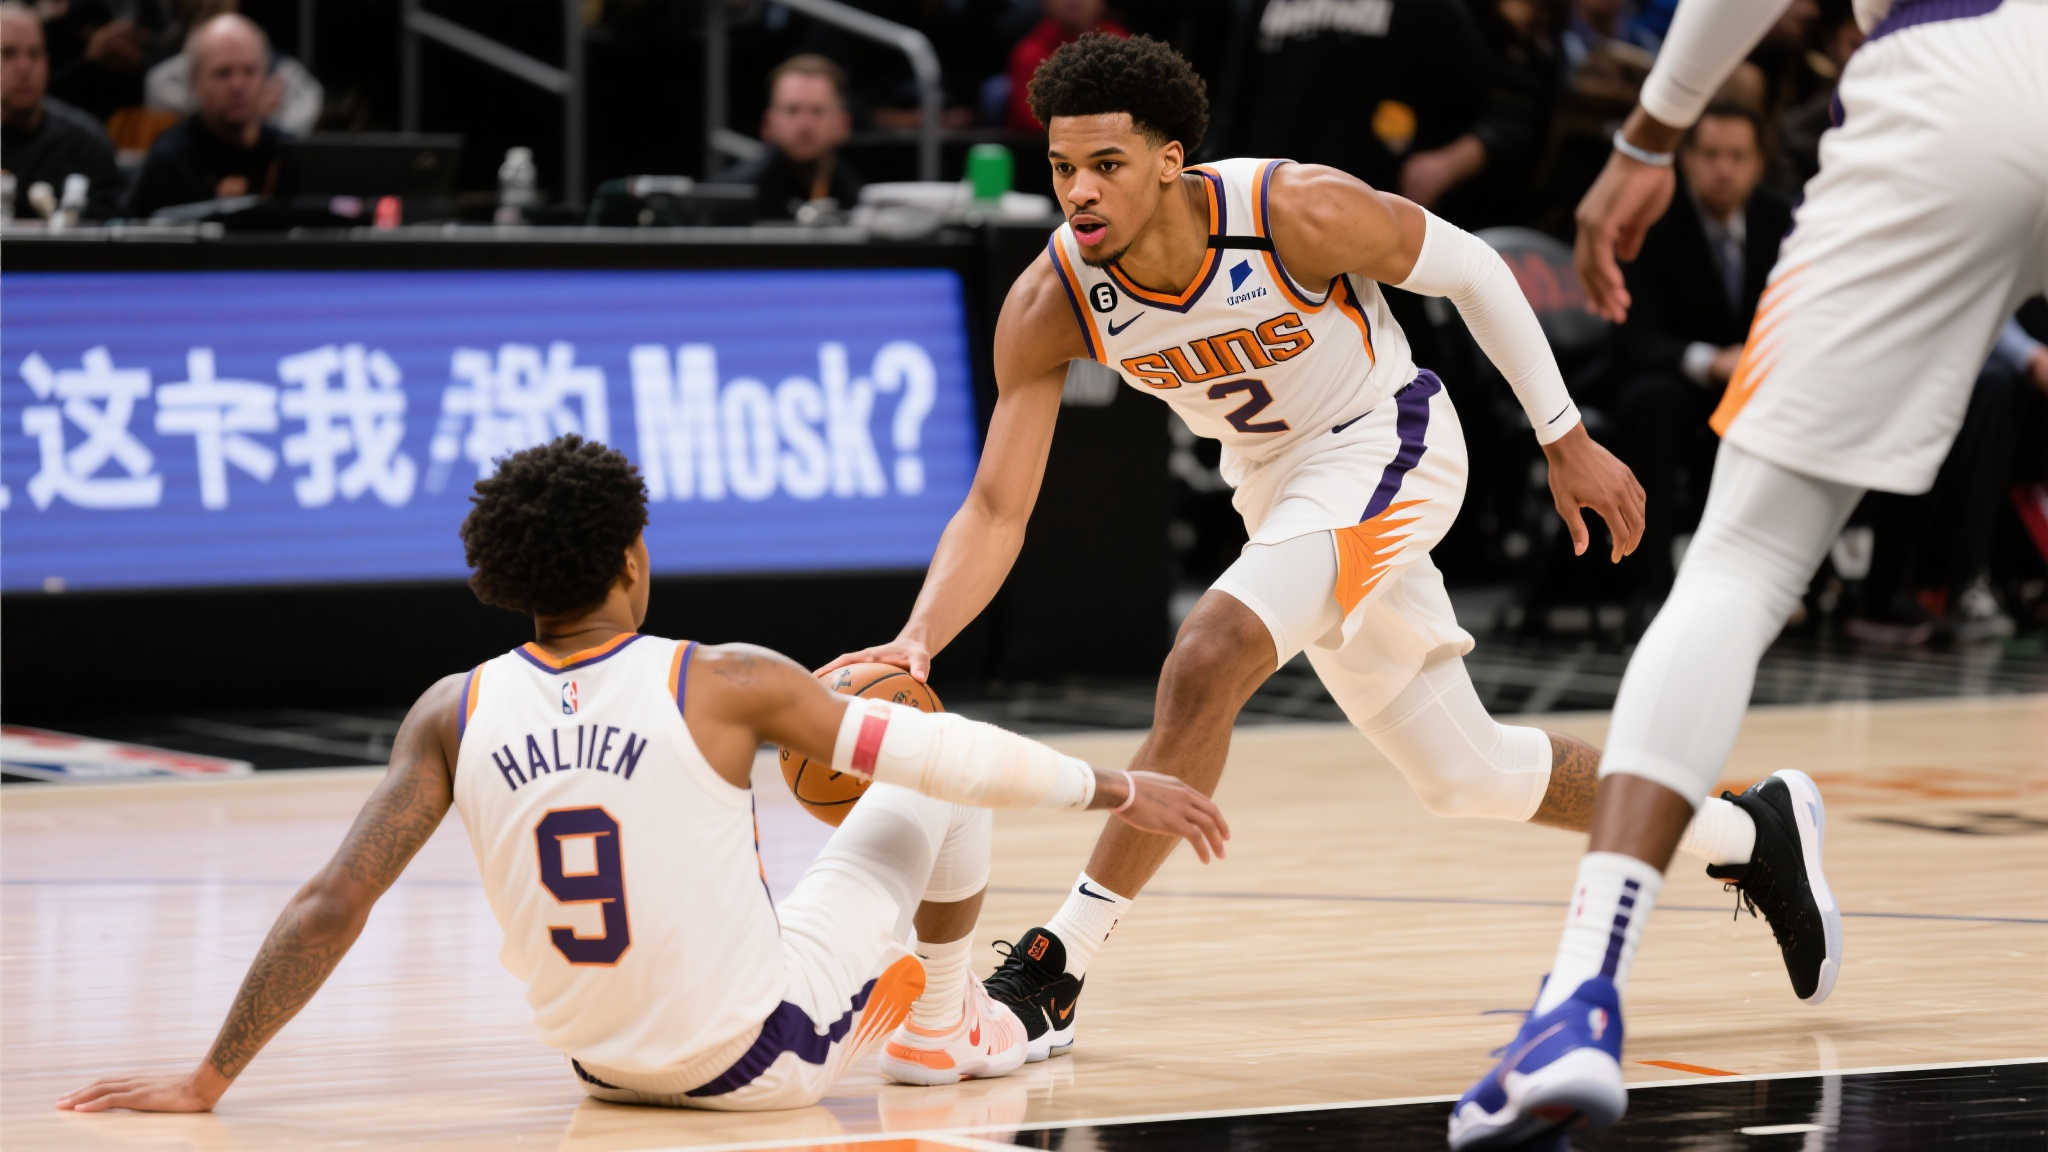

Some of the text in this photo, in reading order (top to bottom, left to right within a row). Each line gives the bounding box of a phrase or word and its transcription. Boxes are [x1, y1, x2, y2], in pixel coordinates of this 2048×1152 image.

[1097, 286, 1113, 310] 6
[1120, 312, 1314, 389] SUNS
[630, 340, 937, 501] Mosk?
[1207, 378, 1291, 433] 2
[533, 804, 632, 968] 9
